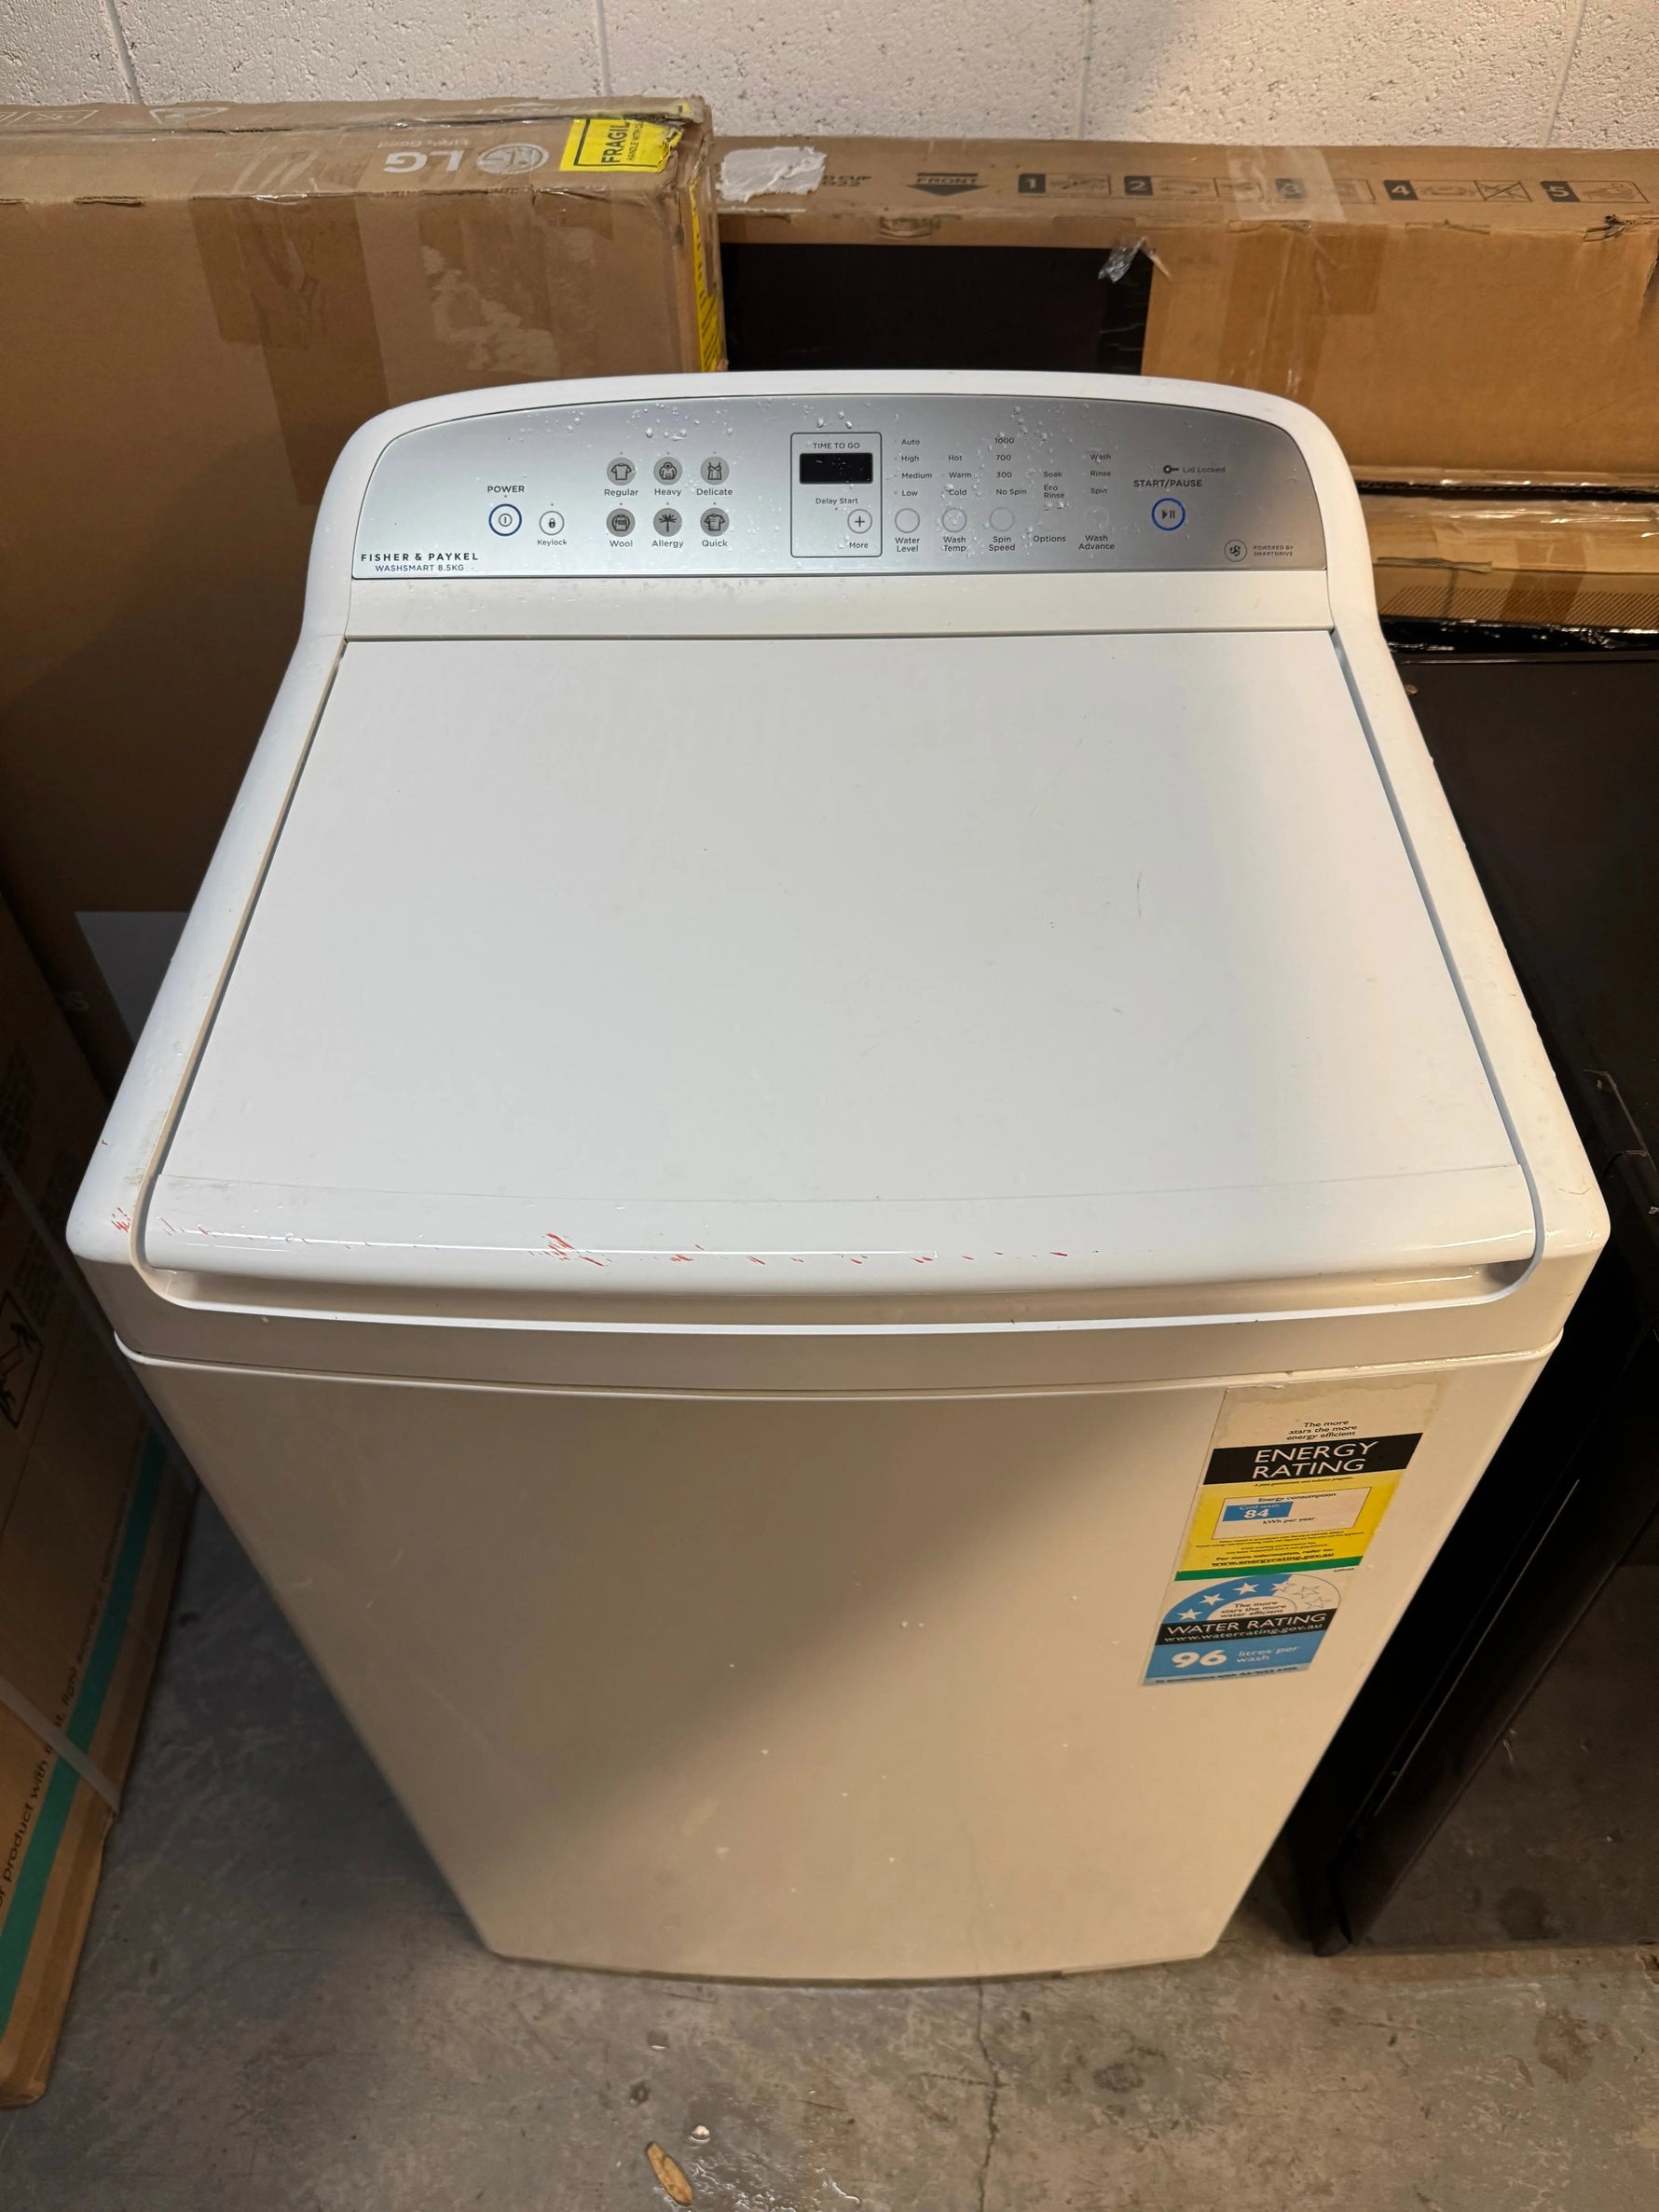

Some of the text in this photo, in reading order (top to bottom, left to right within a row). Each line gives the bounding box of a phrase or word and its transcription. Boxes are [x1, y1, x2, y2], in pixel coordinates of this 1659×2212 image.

[601, 120, 631, 164] FRAGIL
[383, 150, 464, 173] LG
[901, 455, 920, 463] High
[1132, 479, 1203, 488] START/PAUSE
[487, 485, 526, 493] POWER
[604, 488, 638, 498] Regular
[653, 488, 682, 498] Heavy
[696, 488, 734, 497] Delicate
[1008, 488, 1027, 497] Spin
[1090, 487, 1108, 496] Spin
[816, 497, 858, 506] Delay Start
[537, 539, 568, 547] Keylock
[609, 539, 634, 548] Wool
[701, 539, 728, 548] Quick
[992, 535, 1012, 544] Spin
[1033, 534, 1067, 544] Options
[1085, 534, 1108, 543] Wash
[651, 539, 685, 549] Allergy
[896, 544, 919, 553] Level
[943, 544, 967, 554] Temp
[988, 543, 1016, 553] Speed
[1078, 542, 1116, 551] Advance
[361, 552, 479, 562] FISHER & PAYKEL
[1255, 1441, 1379, 1463] ENERGY
[1252, 1458, 1366, 1479] RATING
[1243, 1508, 1269, 1518] 84
[1167, 1613, 1327, 1635] WATER RATING
[1164, 1623, 1323, 1642] www.waterrating.gov.au
[1275, 1646, 1300, 1656] per
[1172, 1649, 1227, 1669] 96
[4, 1803, 34, 1883] product
[30, 1762, 48, 1799] with
